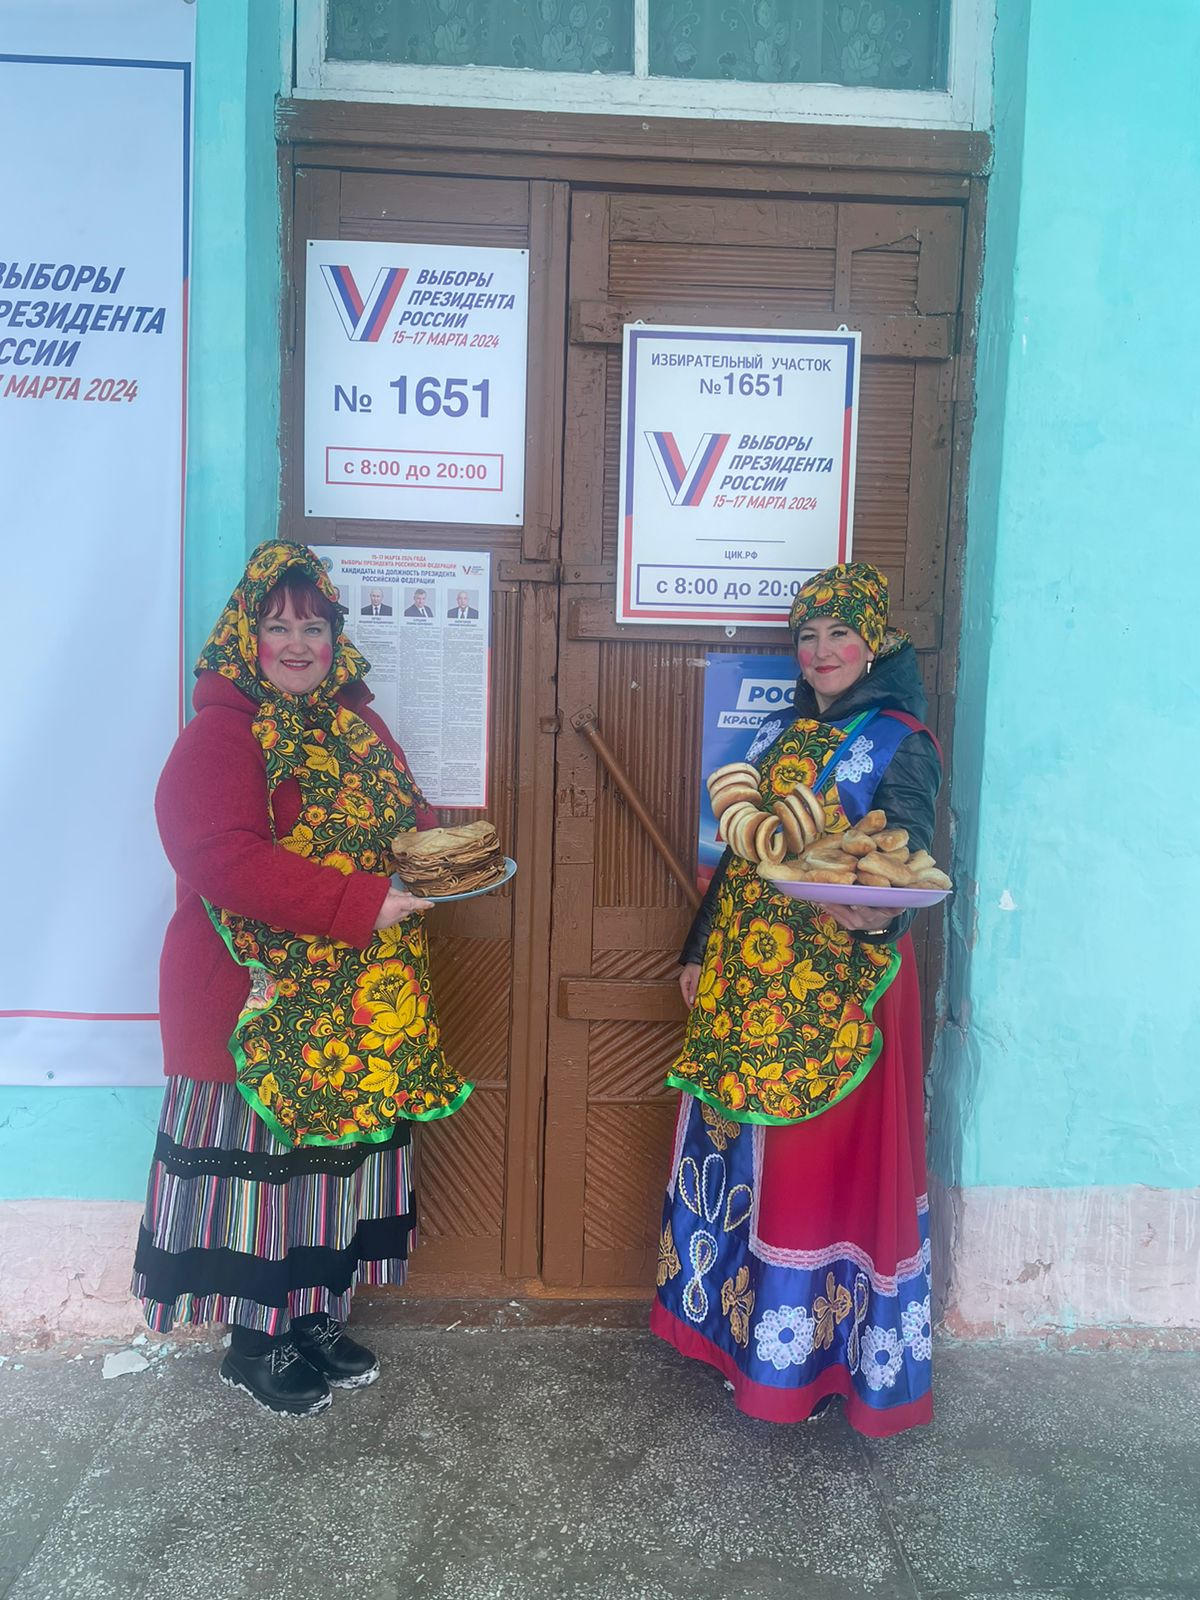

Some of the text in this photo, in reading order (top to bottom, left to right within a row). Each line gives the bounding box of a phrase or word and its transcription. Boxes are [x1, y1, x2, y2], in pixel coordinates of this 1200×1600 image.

[416, 269, 494, 288] ВЫБОРЫ
[407, 290, 516, 310] ПРЕЗИДЕНТА
[0, 299, 167, 334] РЕЗИДЕНТА
[398, 310, 469, 328] РОССИИ
[426, 332, 469, 347] МАРТА
[469, 334, 501, 348] 2024
[0, 337, 82, 367] ССИИ
[651, 352, 832, 372] ИЗБИРАТЕЛЬНЫЙ УЧАСТОК
[3, 375, 82, 400] МАРТА
[83, 378, 139, 402] 2024
[334, 375, 490, 418] № 1651
[737, 434, 813, 452] ВЫБОРЫ
[344, 459, 488, 481] с 8:00 до 20:00
[728, 454, 834, 474] ПРЕЗИДЕНТА
[719, 475, 788, 492] РОССИИ
[746, 495, 787, 510] МАРТА
[788, 497, 817, 511] 2024
[724, 550, 758, 561] ЦИК.РФ
[341, 567, 376, 575] КАНДИДАТЫ
[385, 569, 420, 577] ДОЛЖНОСТЬ
[420, 570, 457, 578] ПРЕЗИДЕНТА
[362, 575, 400, 583] РОССИЙСКОЙ
[656, 578, 801, 599] с 8:00 до 20:0
